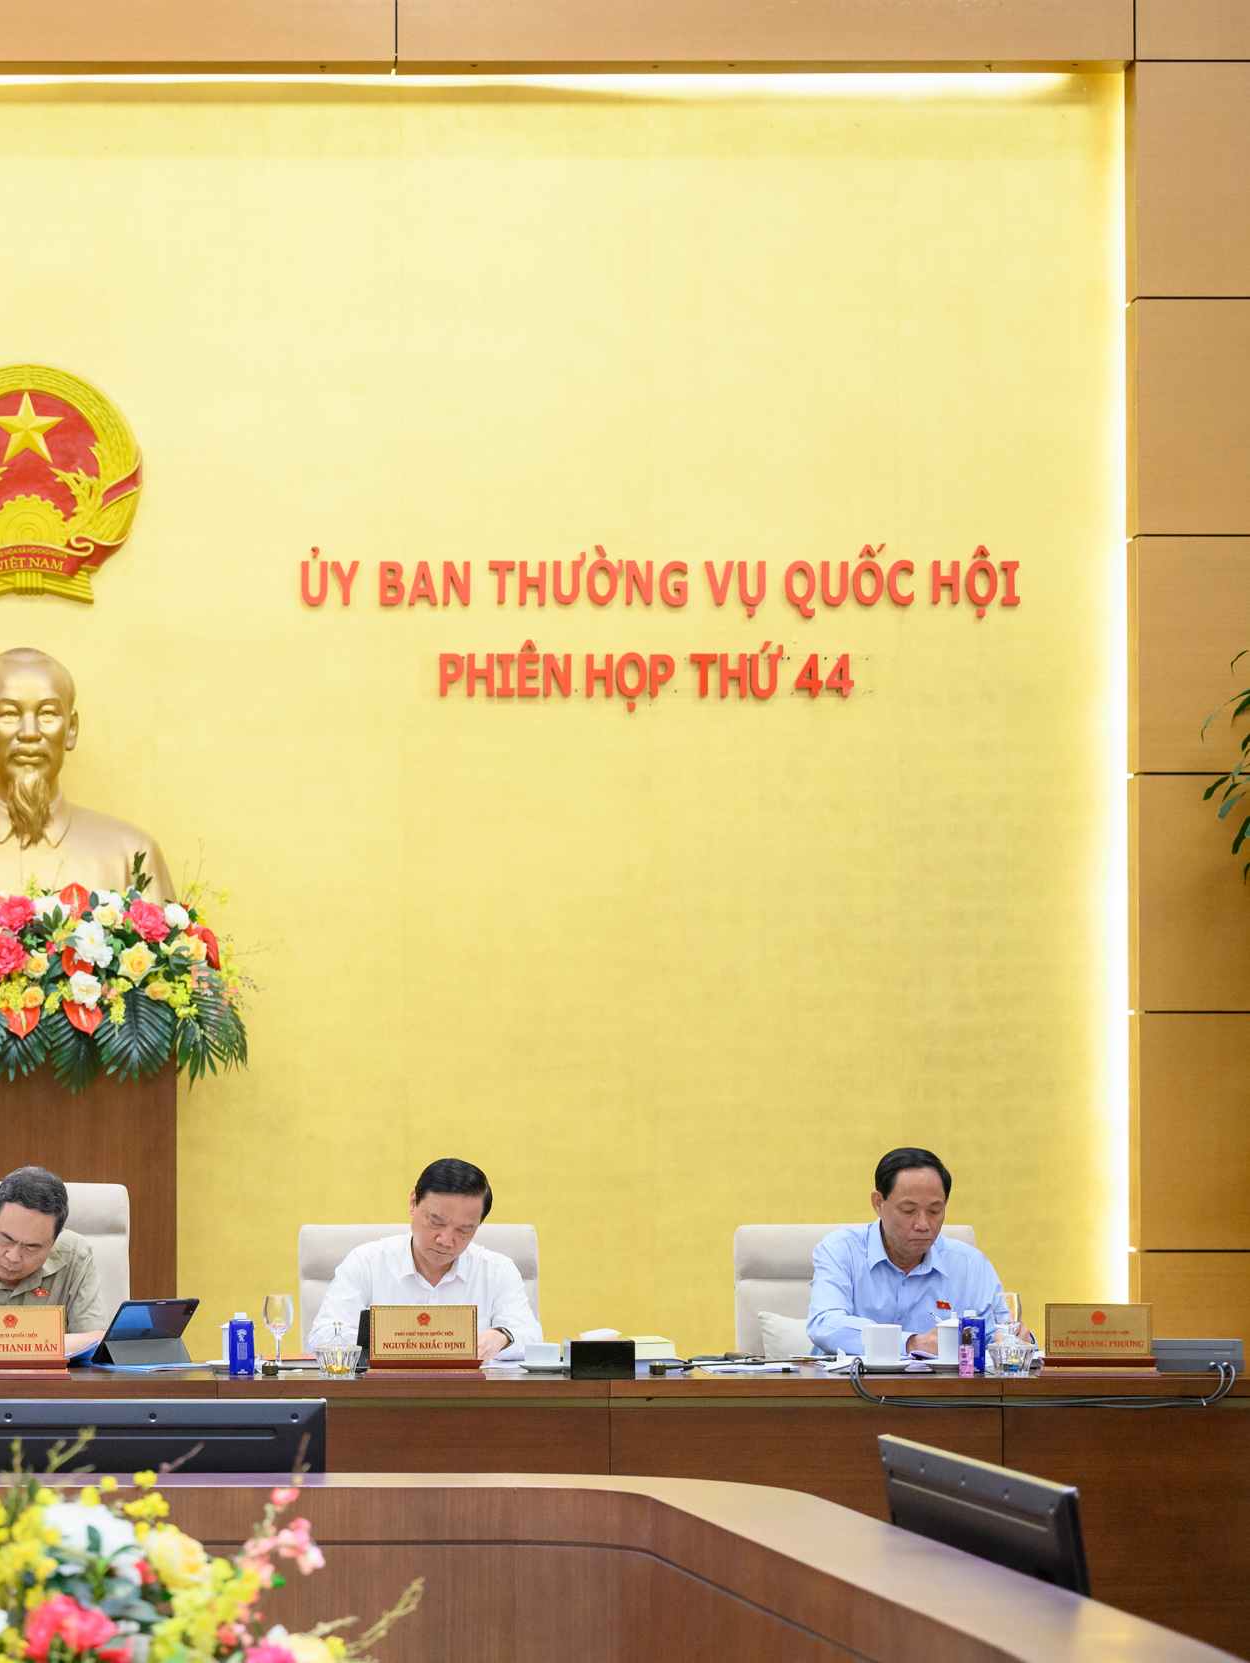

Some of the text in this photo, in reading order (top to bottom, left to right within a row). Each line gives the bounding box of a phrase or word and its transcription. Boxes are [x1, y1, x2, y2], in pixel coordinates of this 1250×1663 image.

[29, 557, 64, 571] NAM
[301, 543, 1020, 618] ỦY BAN THƯỜNG VỤ QUỐC HỘI
[439, 639, 854, 712] PHIÊN HỌP THỨ 44
[34, 1339, 58, 1352] MẪN
[382, 1338, 466, 1350] NGUYỄN KHẮC ĐỊNH
[1077, 1340, 1107, 1348] QUANG
[1109, 1339, 1144, 1347] PHƯƠNG
